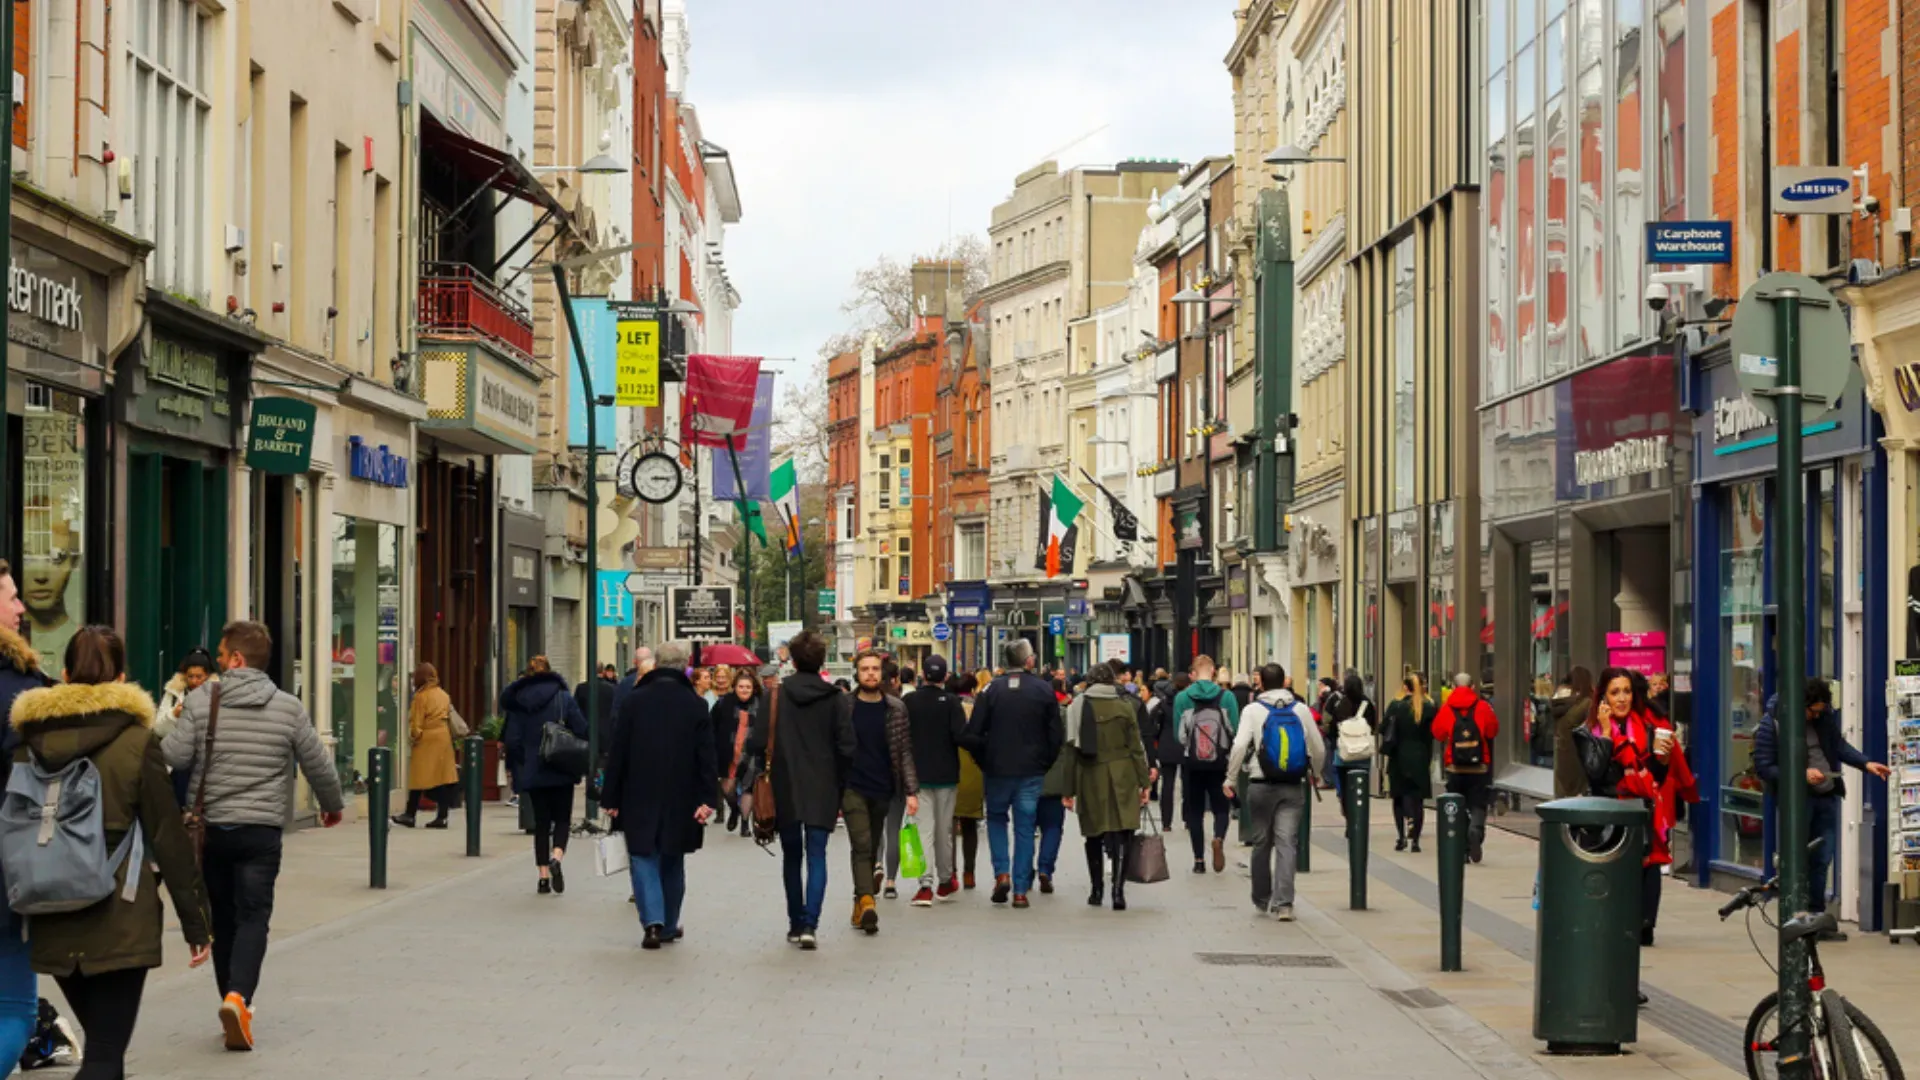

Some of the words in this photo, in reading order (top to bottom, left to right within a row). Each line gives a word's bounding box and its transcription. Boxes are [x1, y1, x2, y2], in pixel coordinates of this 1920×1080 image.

[1789, 185, 1842, 194] SAMSUNG
[1663, 228, 1723, 240] Carphone
[1655, 241, 1725, 252] Warehouse
[39, 276, 84, 332] mark
[627, 331, 651, 345] LET
[40, 418, 78, 433] ARE
[257, 414, 307, 432] HOLLAND
[274, 428, 286, 440] &
[24, 434, 78, 454] PEN
[254, 439, 303, 456] BARRETT
